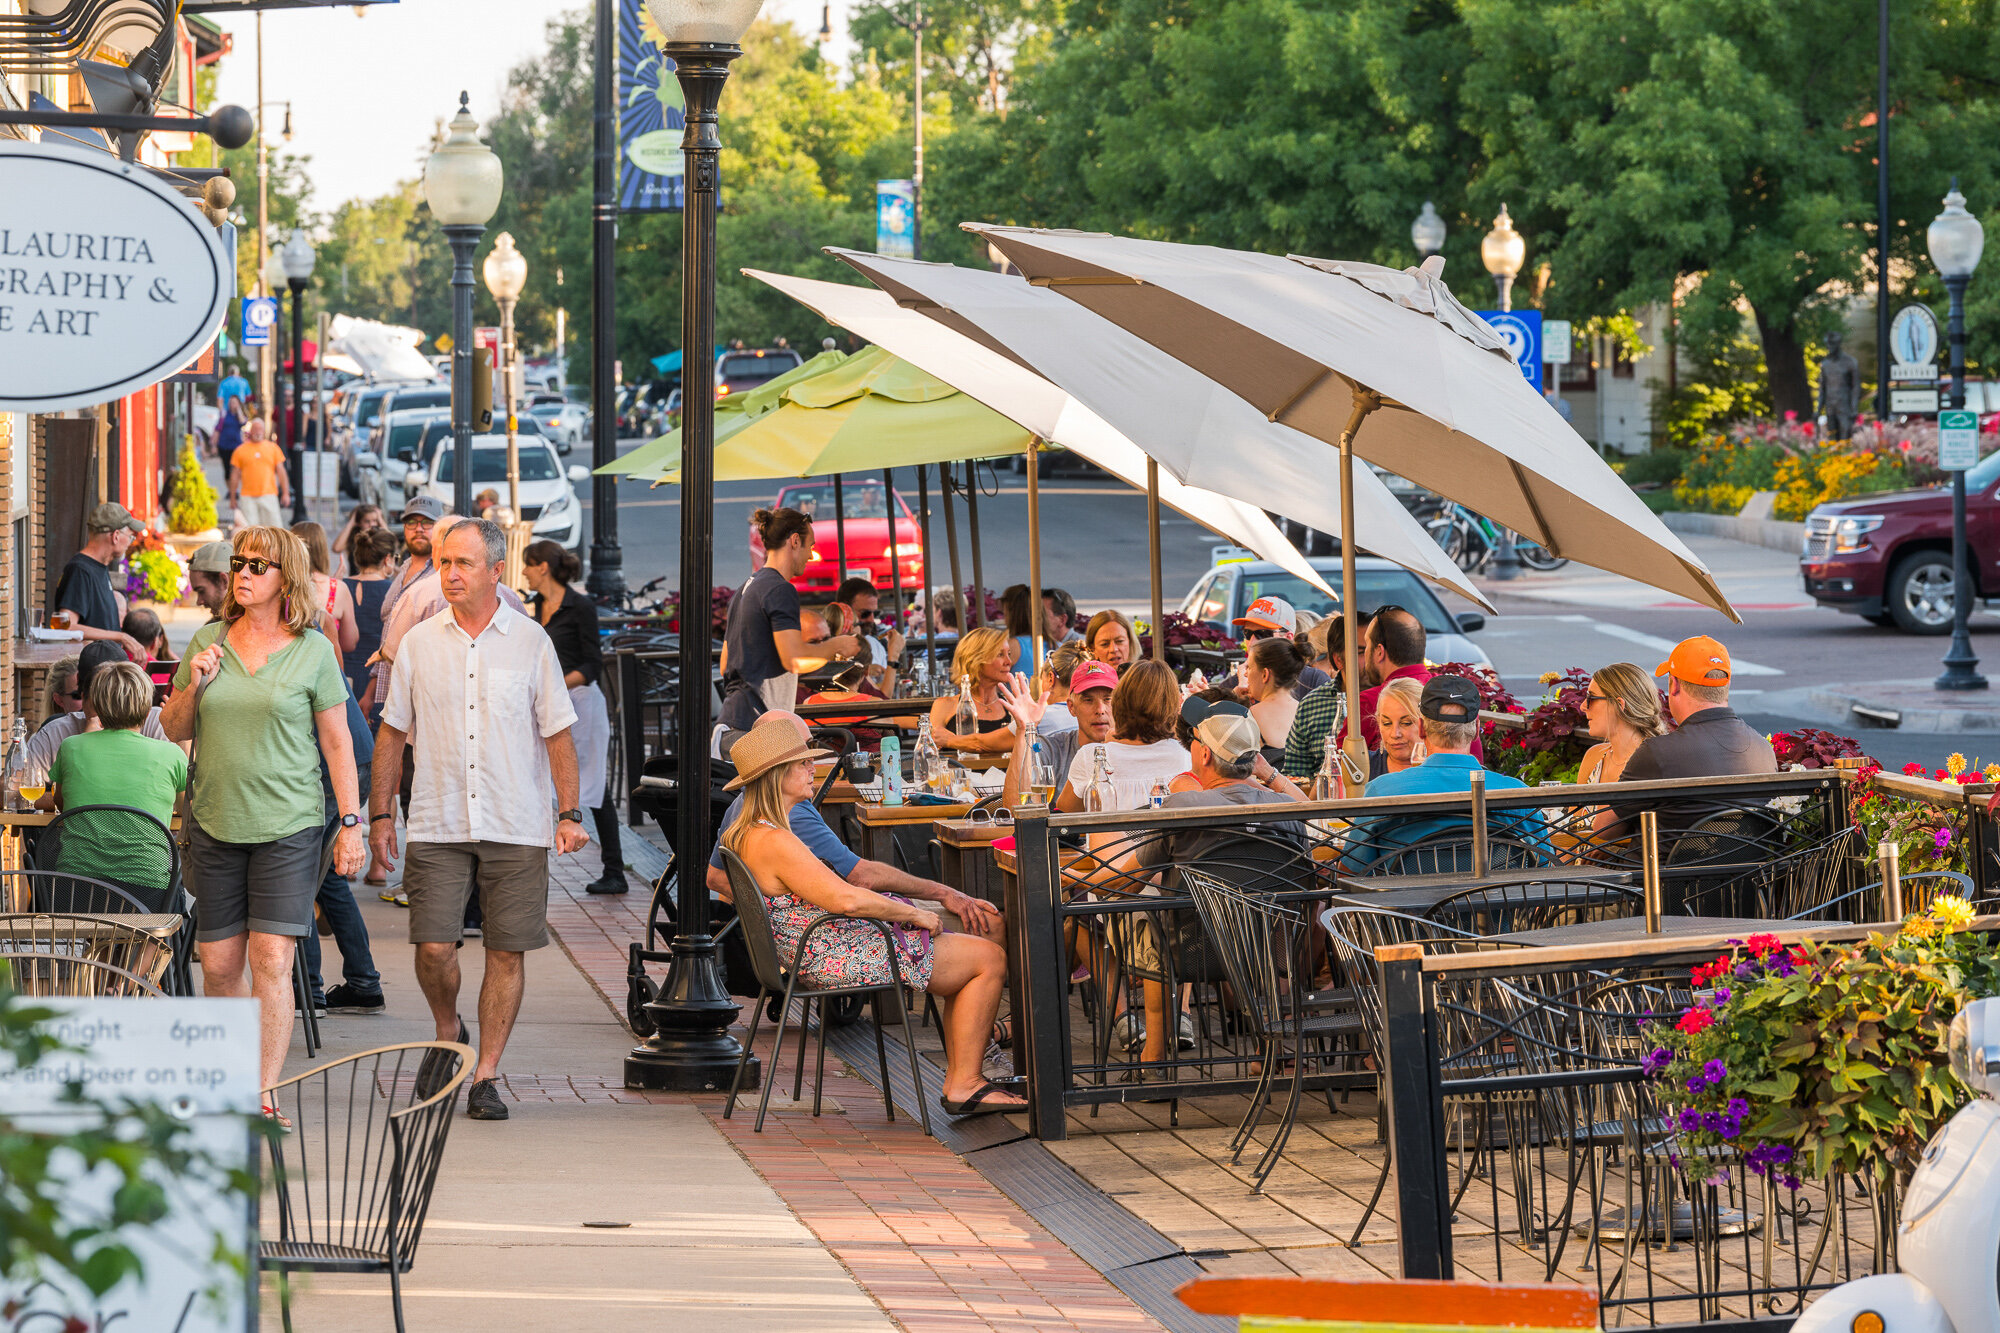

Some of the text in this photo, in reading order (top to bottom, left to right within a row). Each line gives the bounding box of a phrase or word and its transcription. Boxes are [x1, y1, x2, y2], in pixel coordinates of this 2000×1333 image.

[2, 229, 155, 264] LAURITA
[148, 276, 177, 304] &
[27, 308, 100, 336] ART
[58, 1017, 121, 1047] night
[170, 1019, 226, 1047] 6pm
[24, 1060, 71, 1084] and
[79, 1060, 136, 1084] beer
[145, 1067, 176, 1084] on
[186, 1065, 226, 1090] tap
